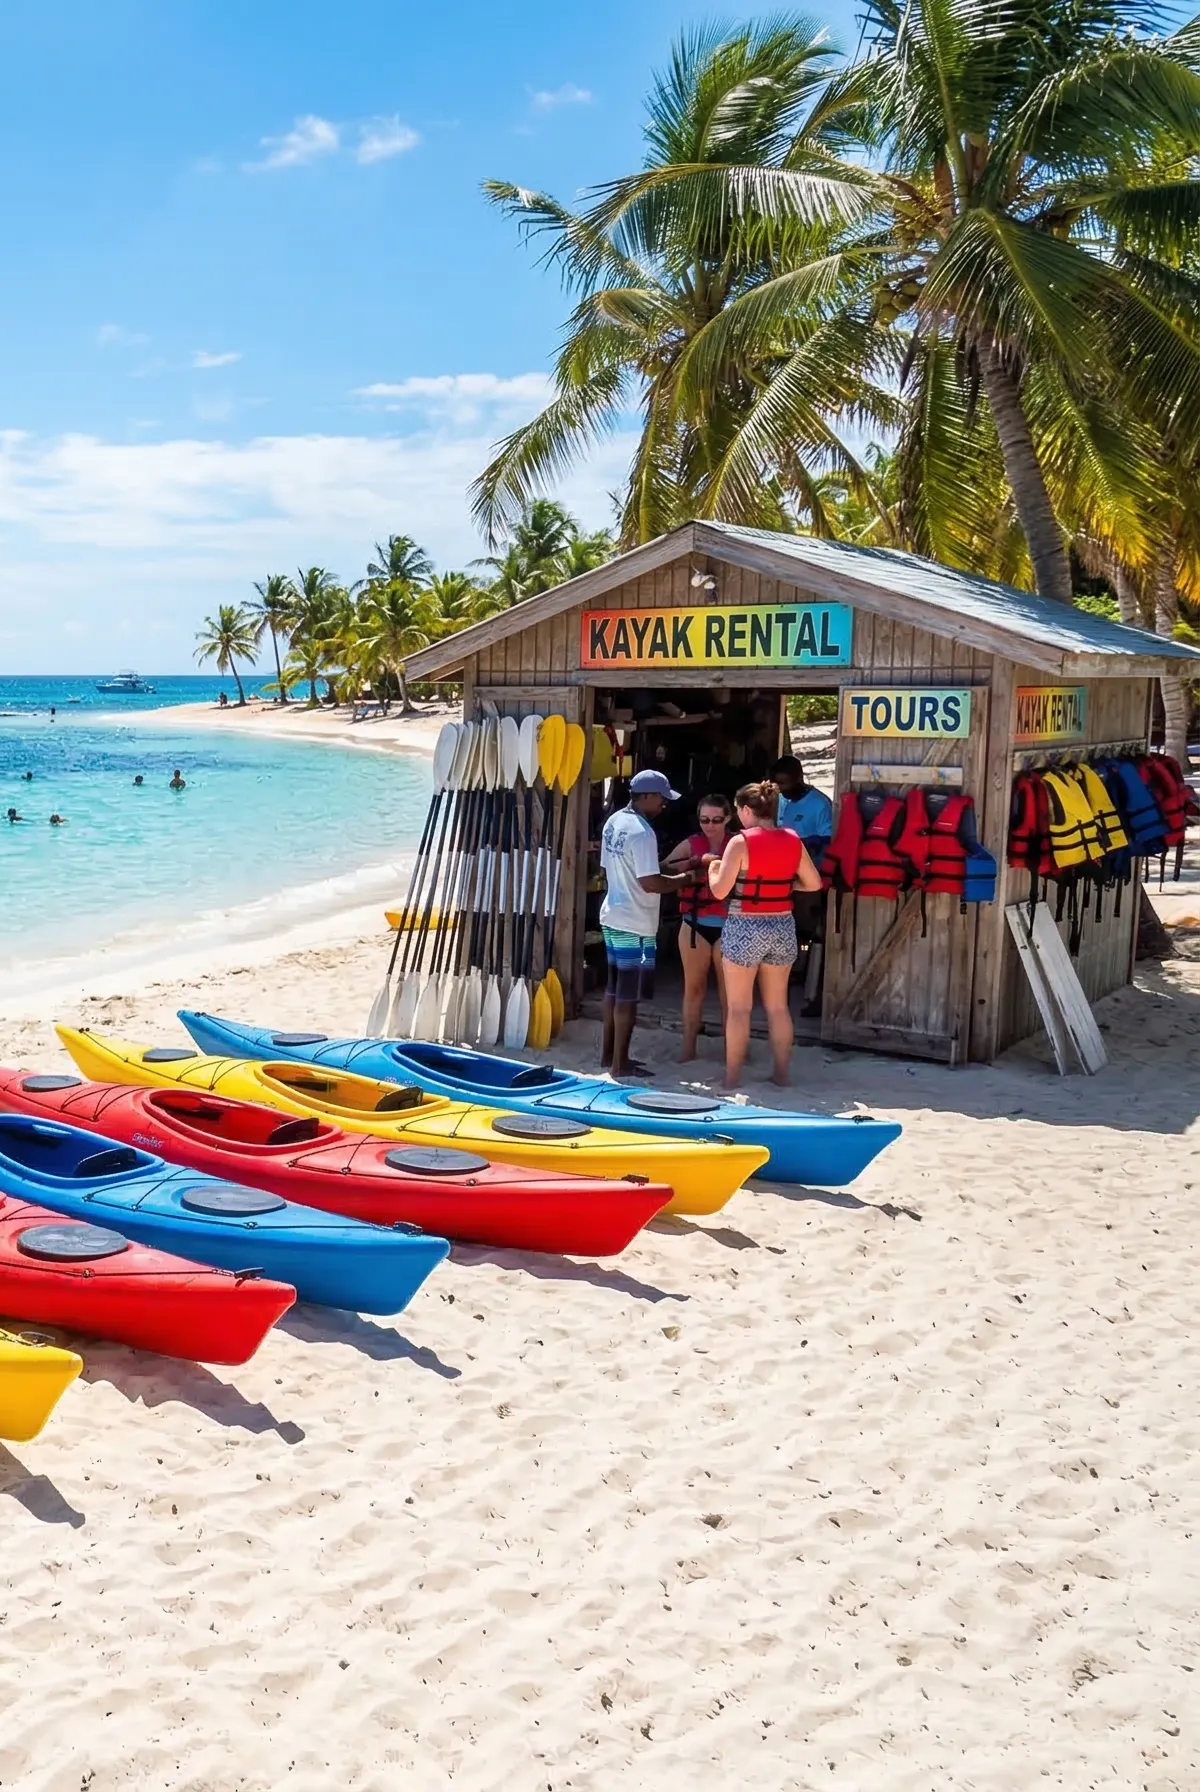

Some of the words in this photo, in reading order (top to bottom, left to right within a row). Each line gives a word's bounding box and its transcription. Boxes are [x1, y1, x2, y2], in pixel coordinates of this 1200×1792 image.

[589, 615, 694, 660] KAYAK
[704, 611, 840, 658] RENTAL
[850, 695, 961, 732] TOURS
[1016, 694, 1048, 735] KAYAK
